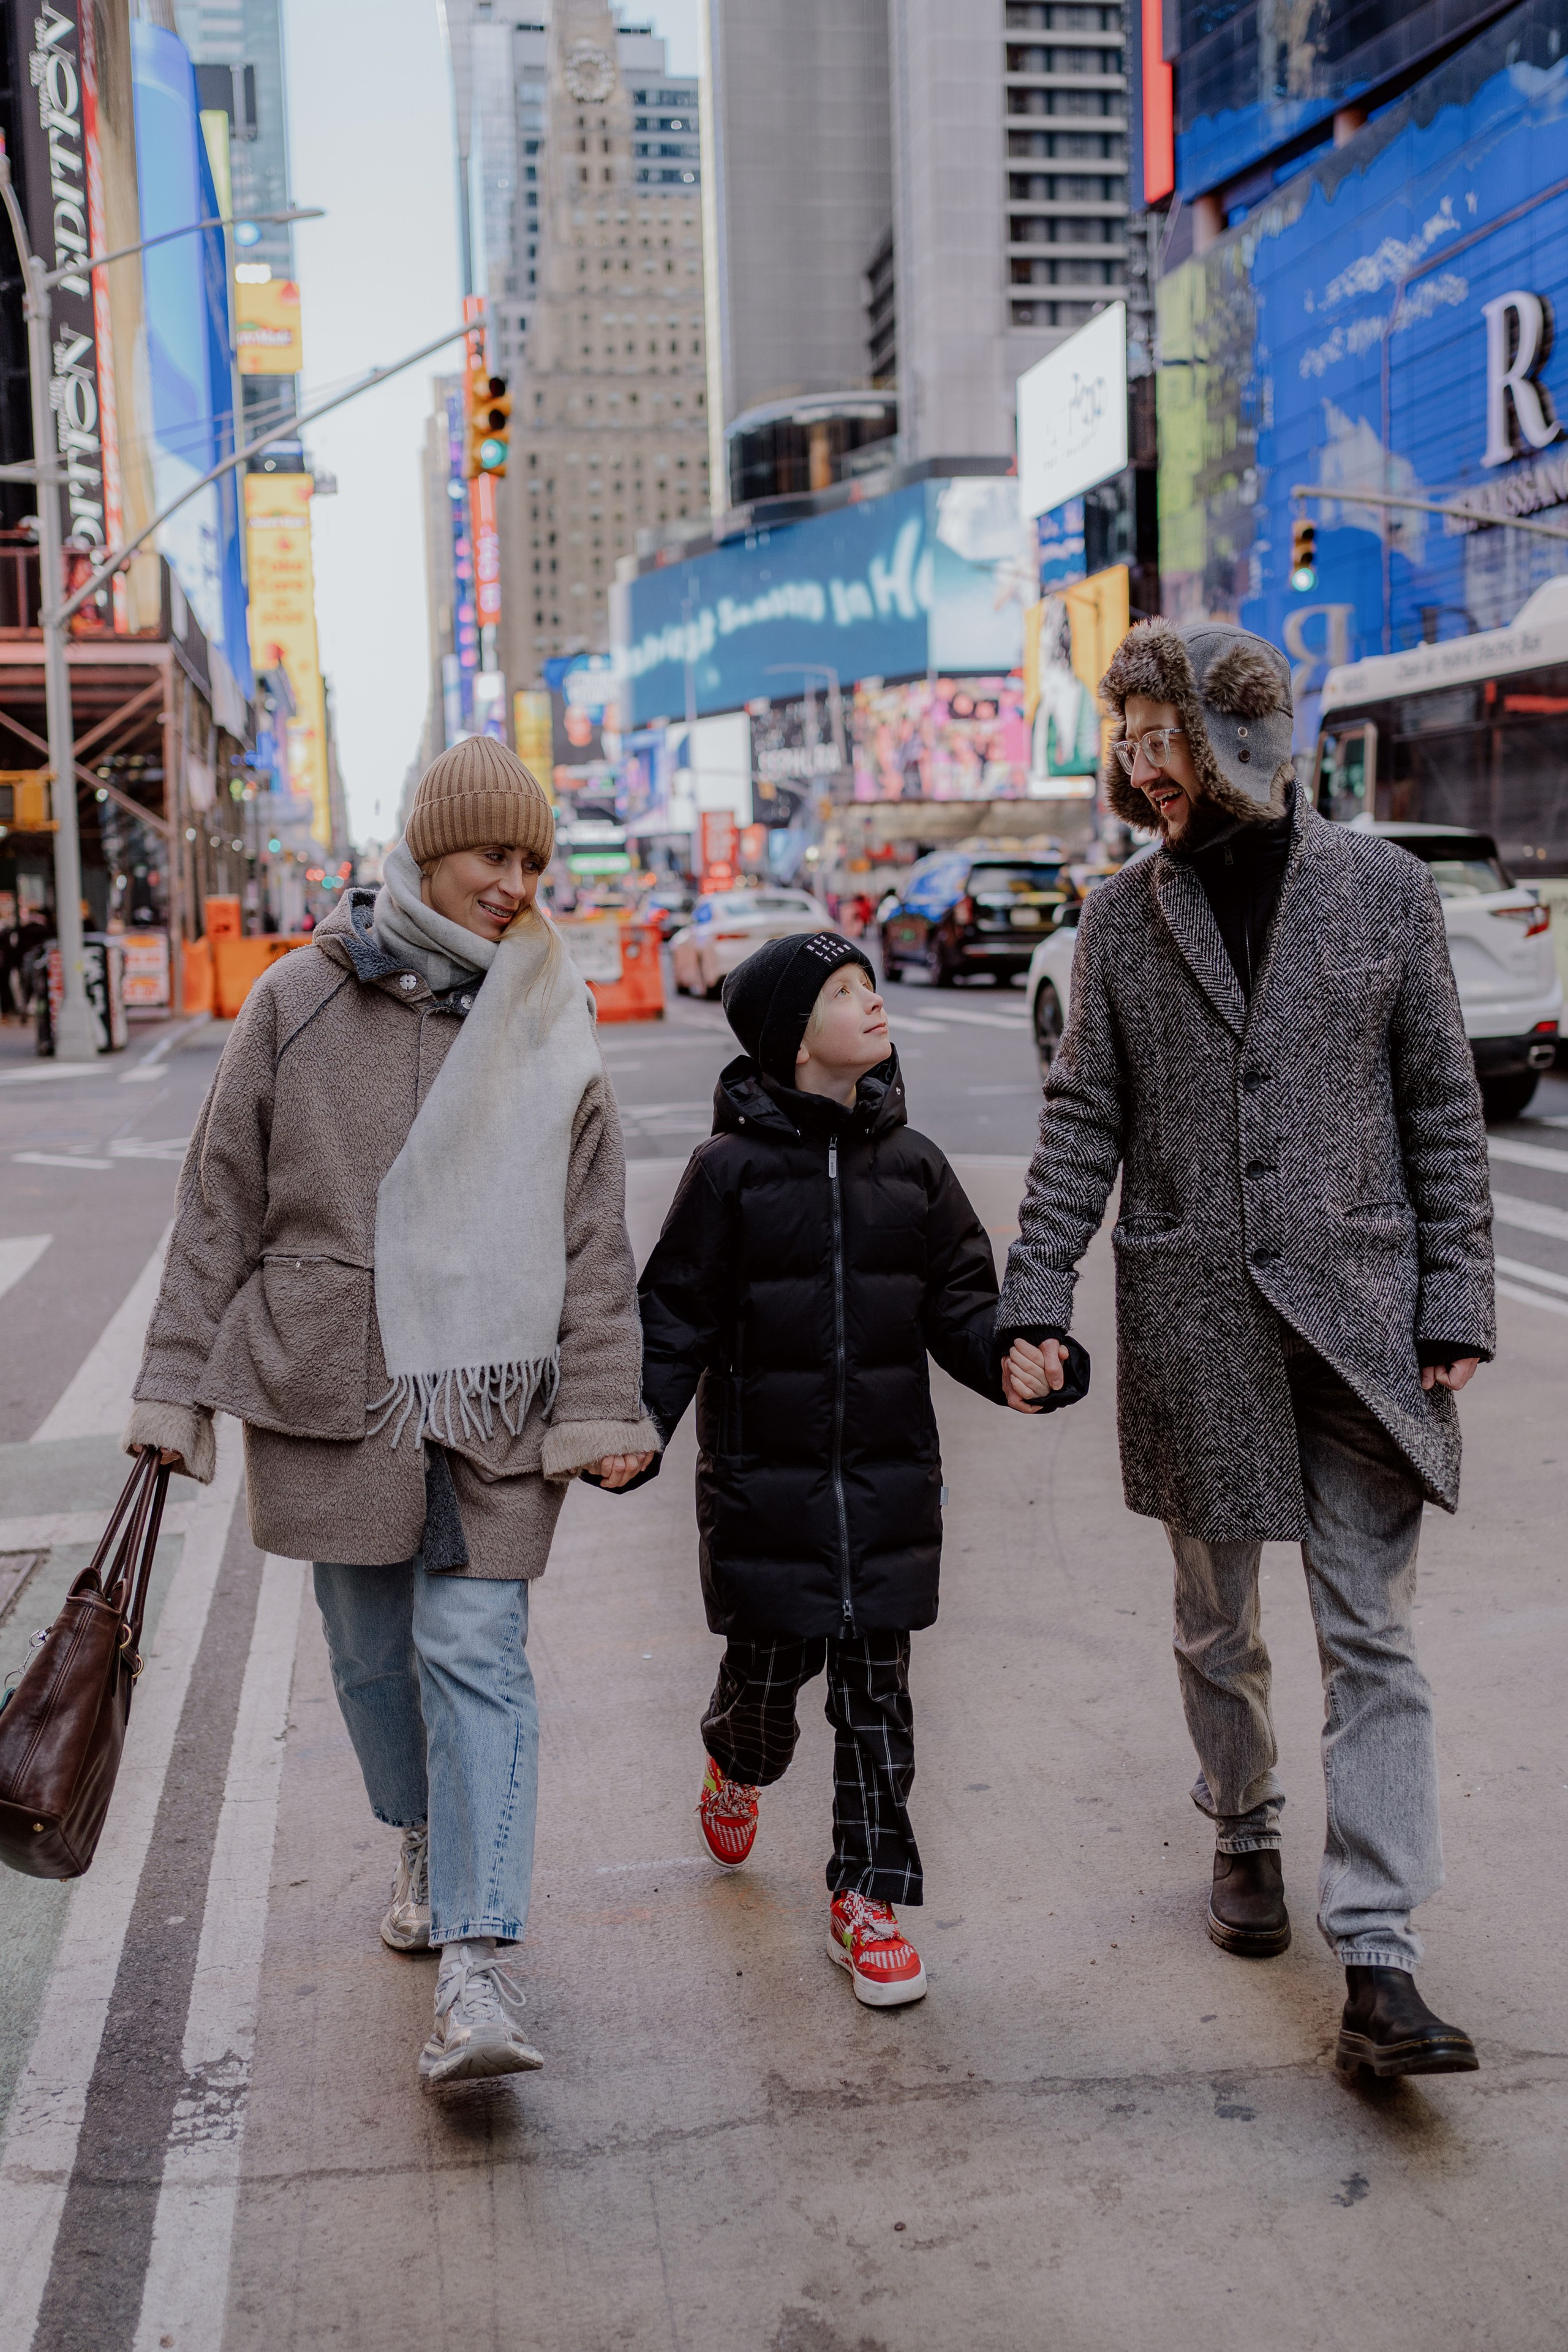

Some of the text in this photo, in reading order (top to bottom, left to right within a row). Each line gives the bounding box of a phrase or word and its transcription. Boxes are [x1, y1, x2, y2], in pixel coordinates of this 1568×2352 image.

[42, 1, 91, 301] EDITION
[806, 935, 827, 951] REF
[815, 941, 843, 957] LEC
